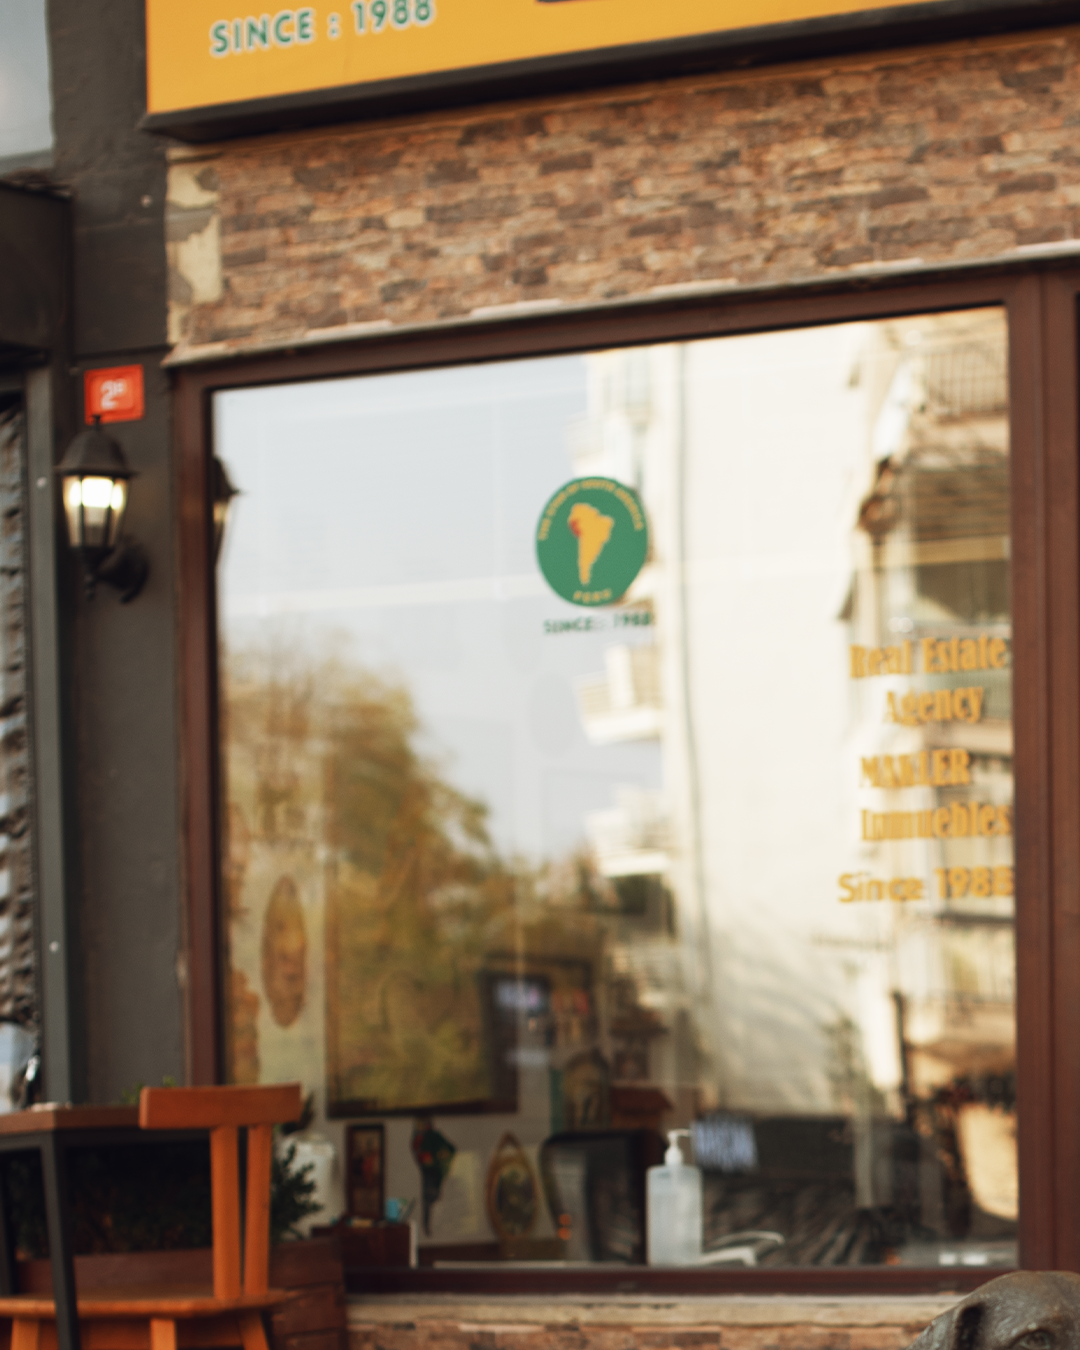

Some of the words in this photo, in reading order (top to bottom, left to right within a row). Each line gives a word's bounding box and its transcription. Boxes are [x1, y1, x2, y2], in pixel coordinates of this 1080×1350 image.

[211, 9, 313, 55] SINCE
[353, 0, 432, 32] 1988
[543, 616, 592, 634] SINCE
[850, 640, 912, 678] Real
[921, 635, 1007, 673] Estate
[884, 686, 984, 726] Agency
[838, 871, 924, 903] Since
[934, 865, 1014, 899] 1988
